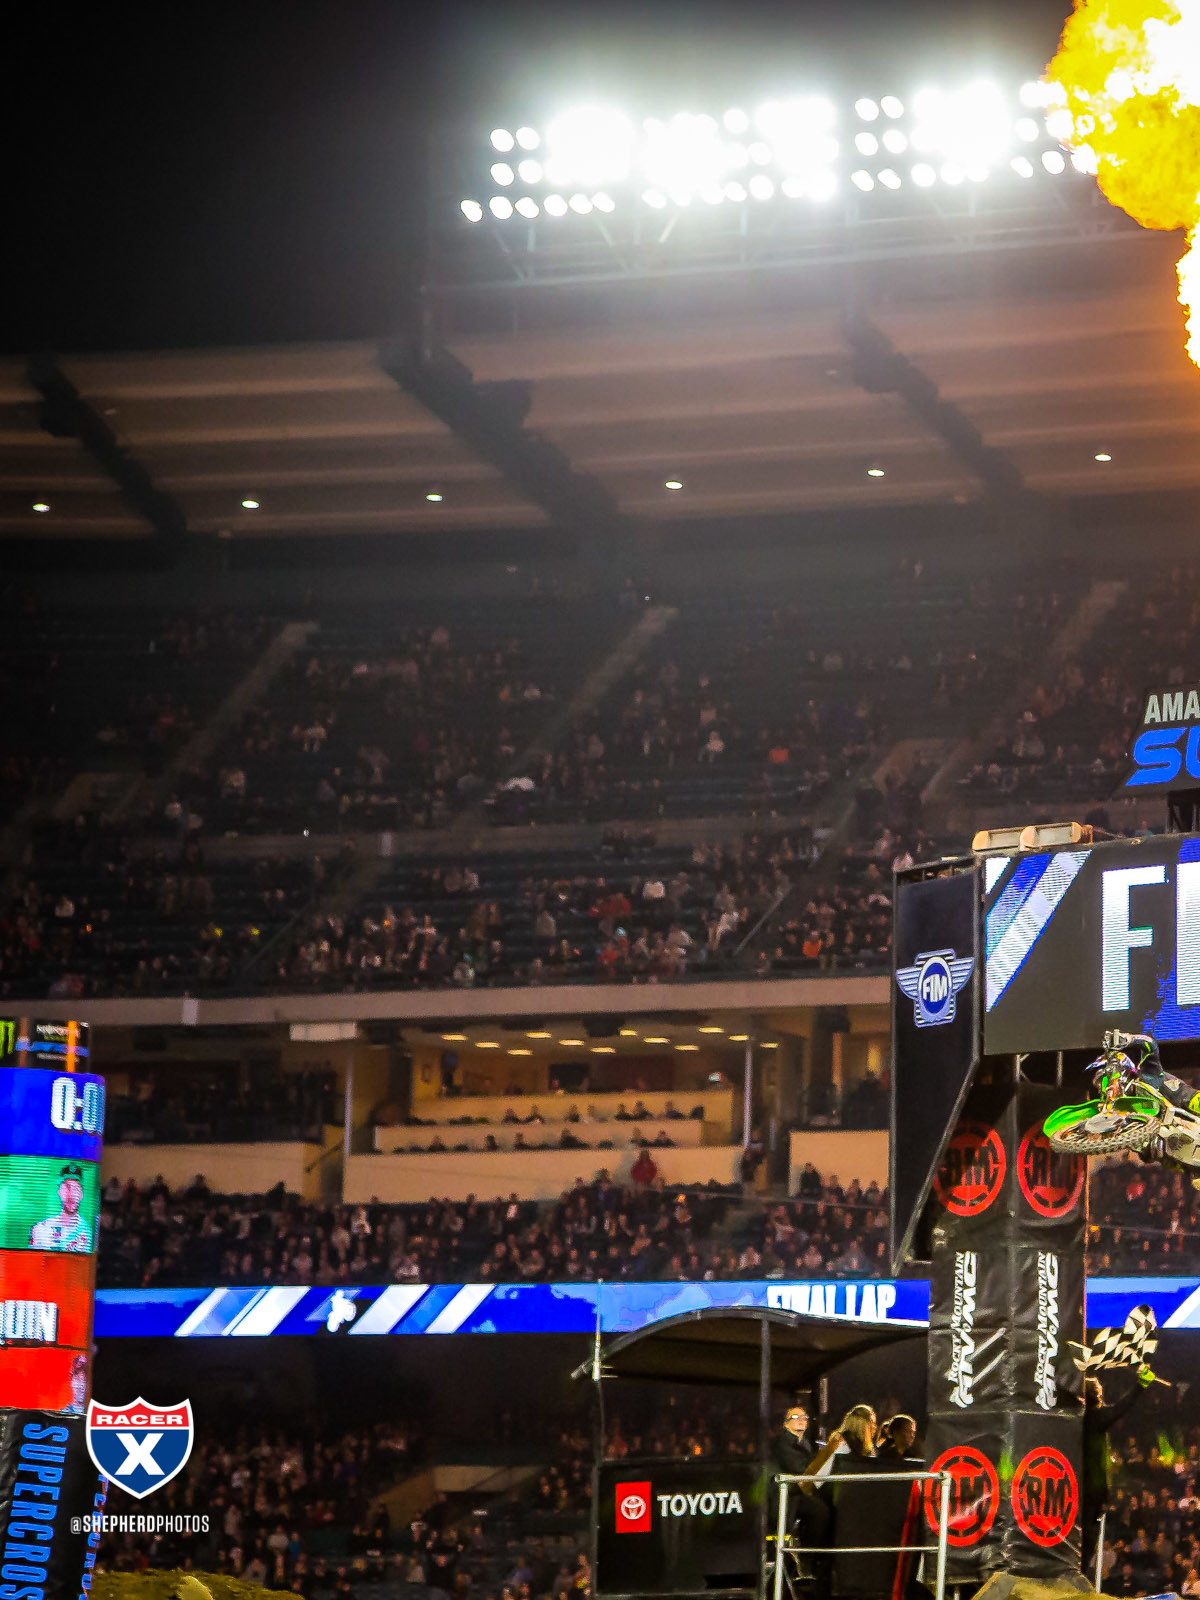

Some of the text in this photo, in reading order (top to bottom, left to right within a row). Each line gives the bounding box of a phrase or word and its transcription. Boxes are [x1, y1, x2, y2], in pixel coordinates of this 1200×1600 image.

[1144, 689, 1200, 724] AMA
[923, 973, 948, 1003] FIM
[657, 1491, 743, 1517] TOYOTA
